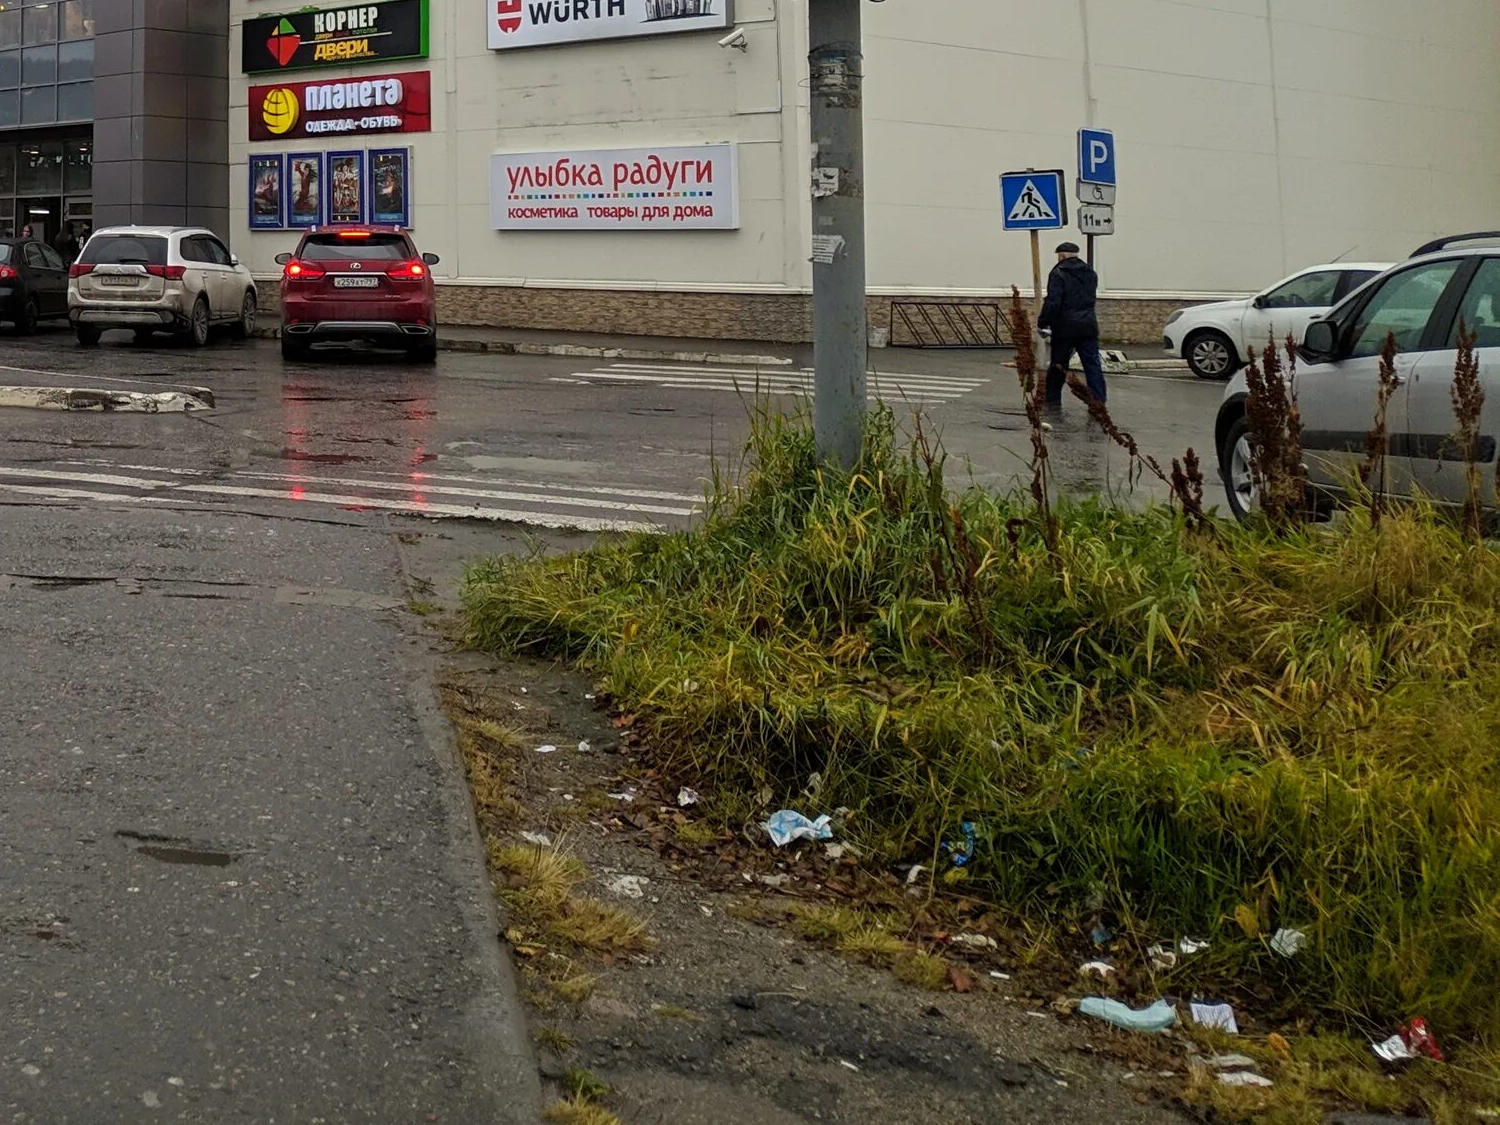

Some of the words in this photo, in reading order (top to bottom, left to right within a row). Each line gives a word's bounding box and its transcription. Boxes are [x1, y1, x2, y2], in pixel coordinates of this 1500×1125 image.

[314, 6, 378, 34] КОРНЕР
[314, 39, 368, 61] двери
[1090, 140, 1108, 173] P
[507, 158, 603, 193] улыбка
[613, 155, 713, 191] радуги
[508, 206, 578, 219] косметика
[587, 205, 638, 221] товары
[642, 206, 670, 221] для
[673, 204, 713, 221] дома
[1083, 213, 1094, 226] 11
